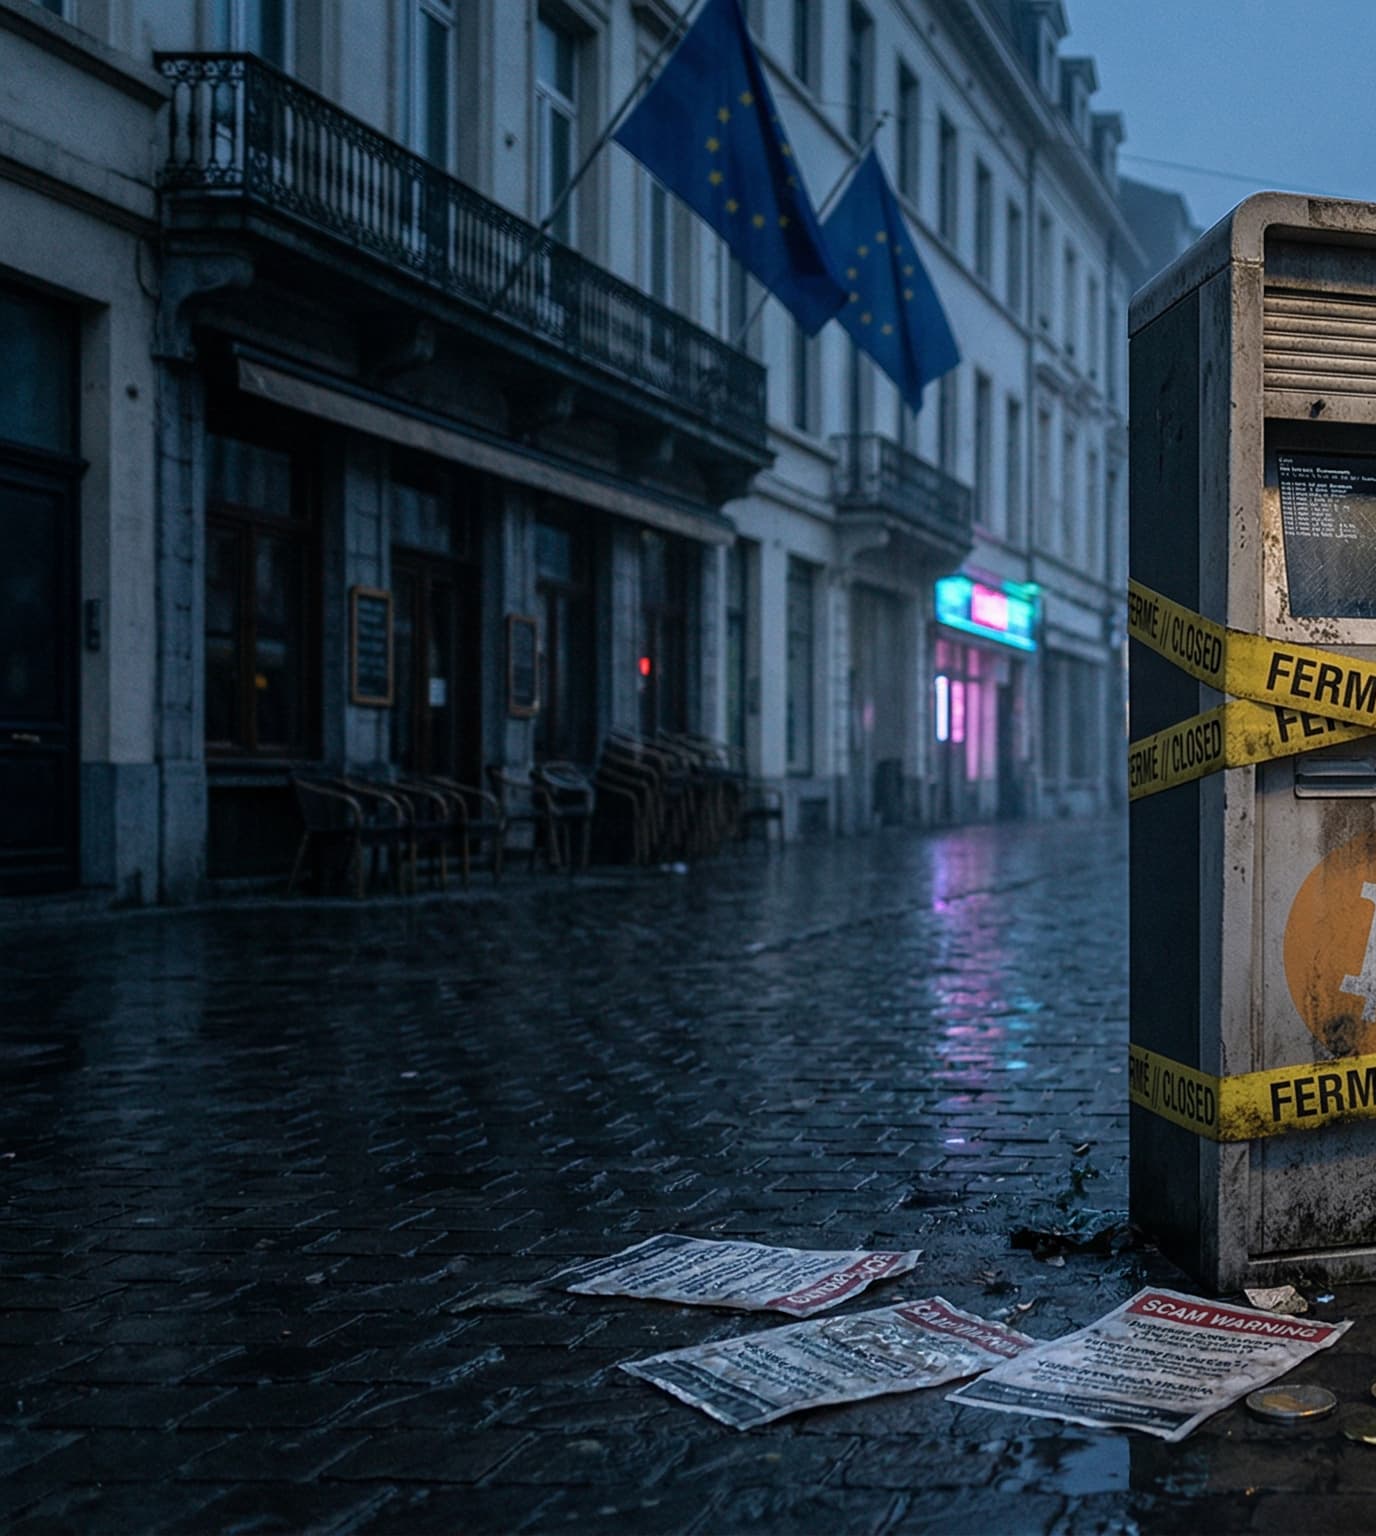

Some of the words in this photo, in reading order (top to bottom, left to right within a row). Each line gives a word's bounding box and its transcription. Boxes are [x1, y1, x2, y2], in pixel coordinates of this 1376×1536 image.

[1128, 591, 1159, 639] ERMÉ
[1172, 616, 1222, 674] CLOSED
[1172, 719, 1222, 772] CLOSED
[1163, 1070, 1215, 1126] CLOSED
[1142, 1299, 1208, 1322] SCAM
[1210, 1313, 1319, 1338] WARNING
